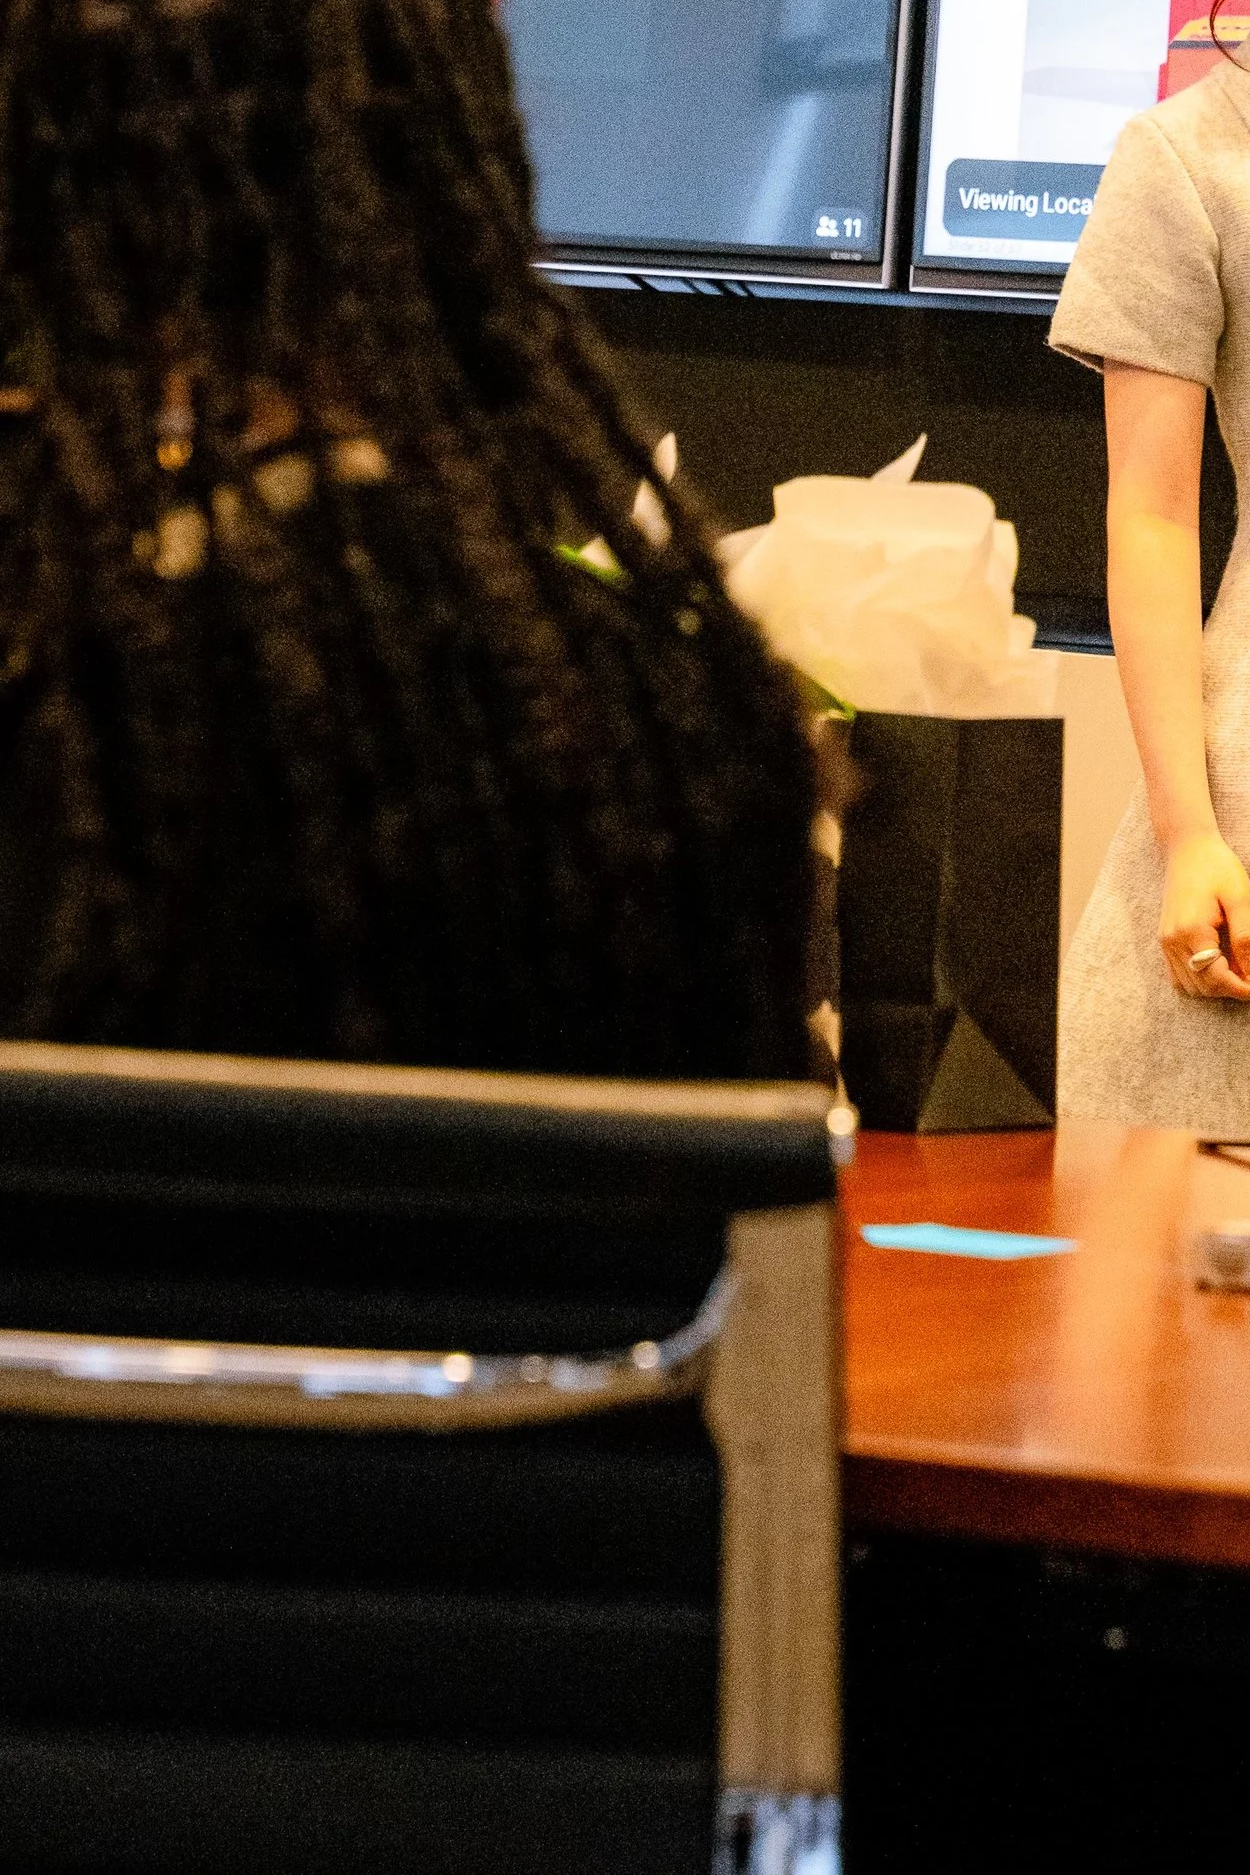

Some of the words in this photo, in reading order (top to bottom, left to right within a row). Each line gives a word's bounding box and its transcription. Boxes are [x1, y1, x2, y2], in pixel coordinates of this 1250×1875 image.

[958, 187, 1039, 218] Viewing
[1042, 190, 1097, 216] Loca
[843, 217, 862, 238] 11
